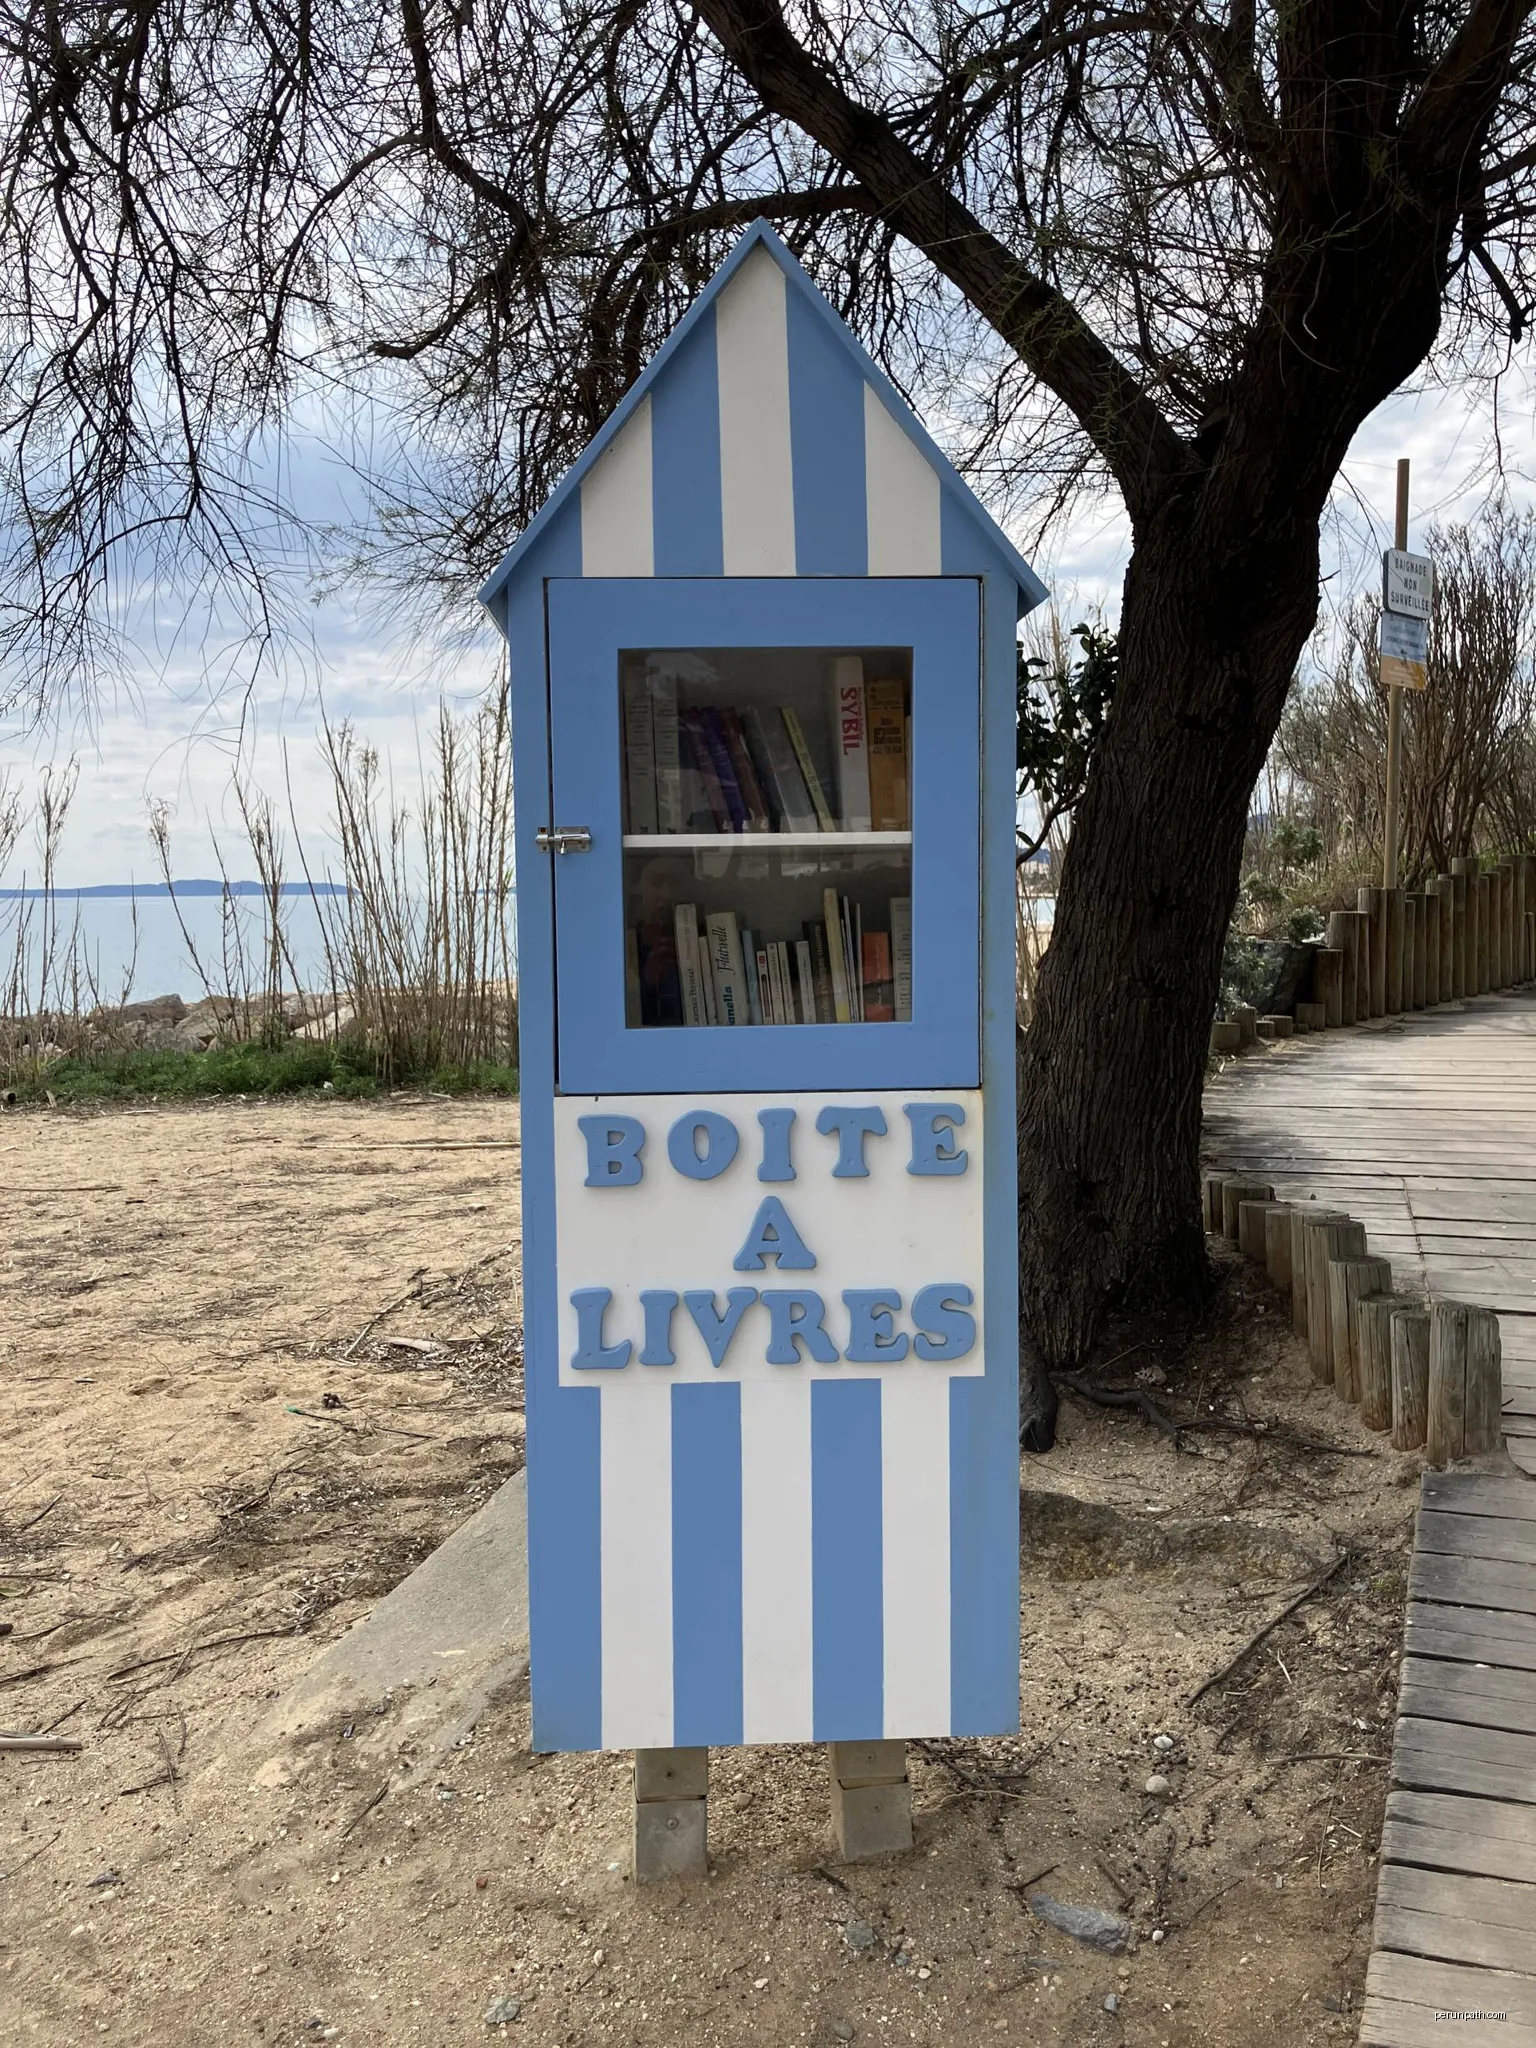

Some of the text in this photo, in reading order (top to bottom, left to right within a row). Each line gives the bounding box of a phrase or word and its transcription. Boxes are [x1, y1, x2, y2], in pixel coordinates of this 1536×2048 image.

[1394, 556, 1428, 578] BAIGNADE
[1403, 577, 1418, 592] NON
[840, 687, 861, 756] SYBIL
[577, 1103, 969, 1188] BOITE
[732, 1195, 817, 1272] A
[569, 1283, 977, 1370] LIVRES
